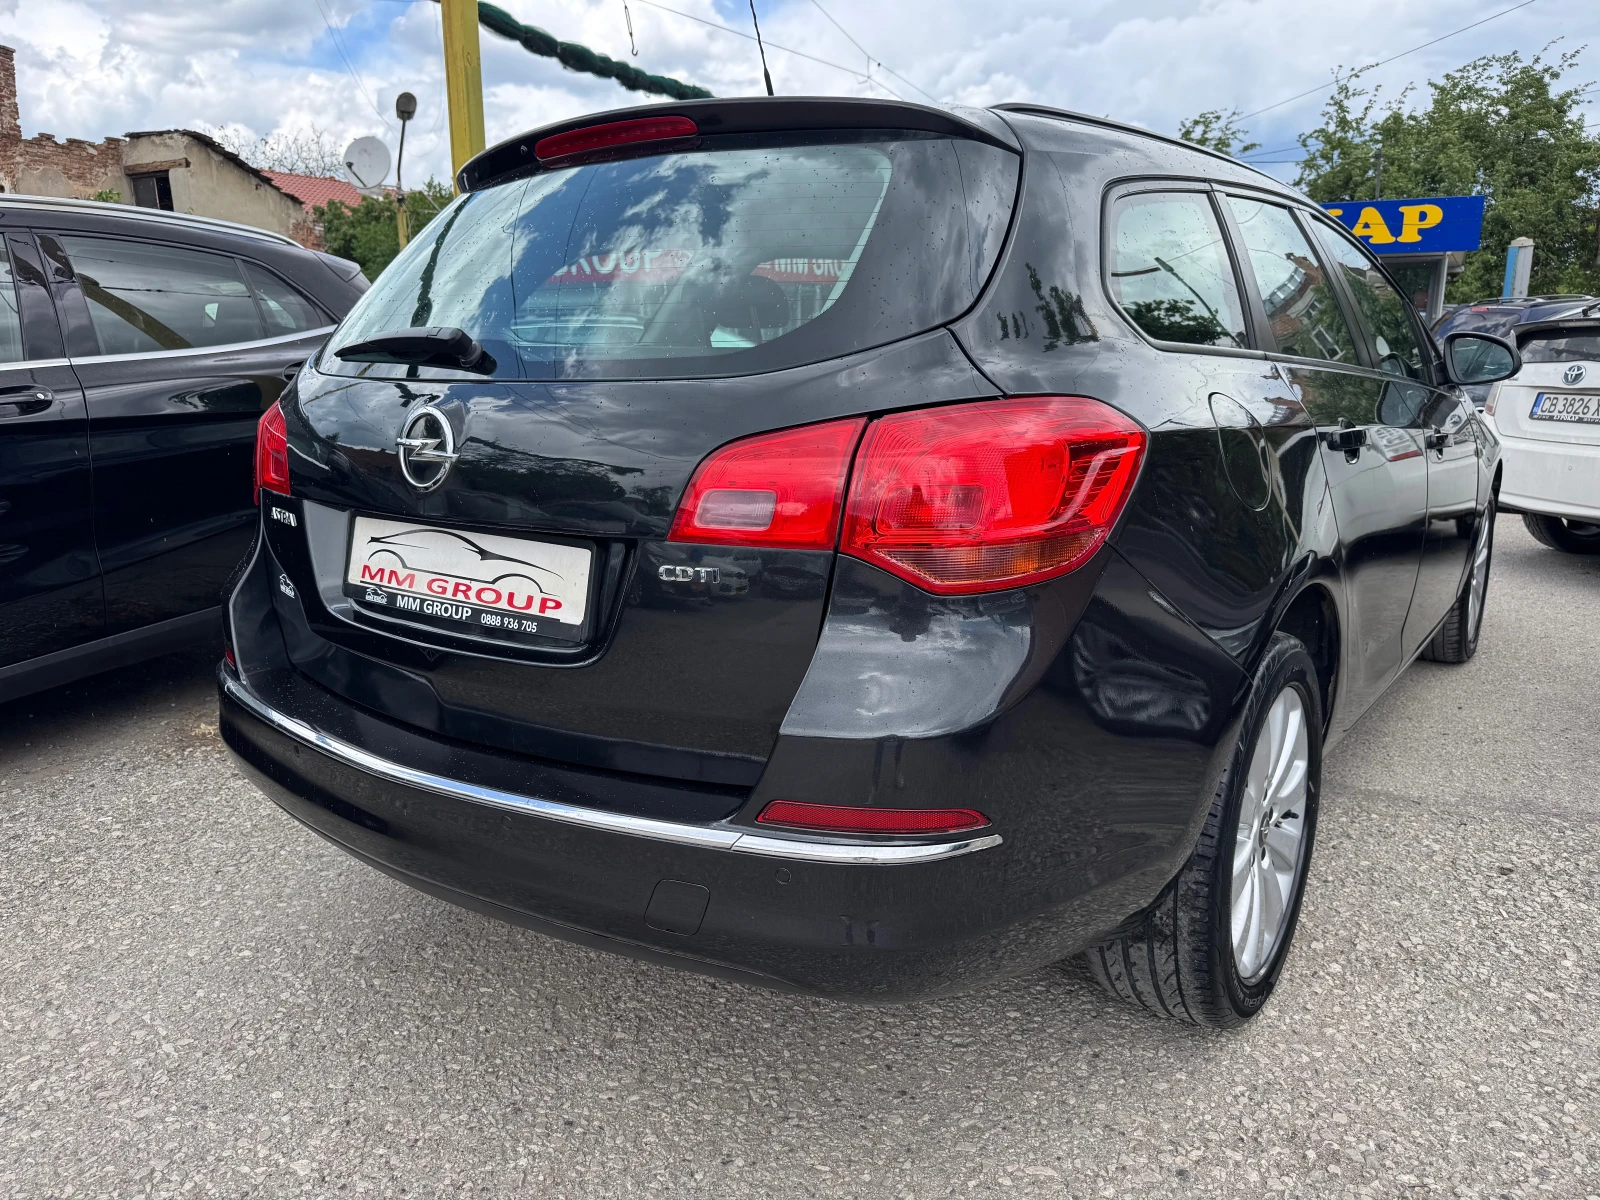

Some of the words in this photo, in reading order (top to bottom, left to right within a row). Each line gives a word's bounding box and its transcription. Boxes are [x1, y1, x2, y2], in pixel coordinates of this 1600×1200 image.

[1558, 396, 1592, 416] 3826
[658, 564, 720, 584] CDTI
[361, 564, 416, 589] MM
[426, 577, 563, 614] GROUP
[396, 594, 421, 612] MM
[423, 600, 472, 621] GROUP
[480, 612, 502, 627] 0888
[503, 617, 519, 630] 936
[521, 620, 538, 633] 705
